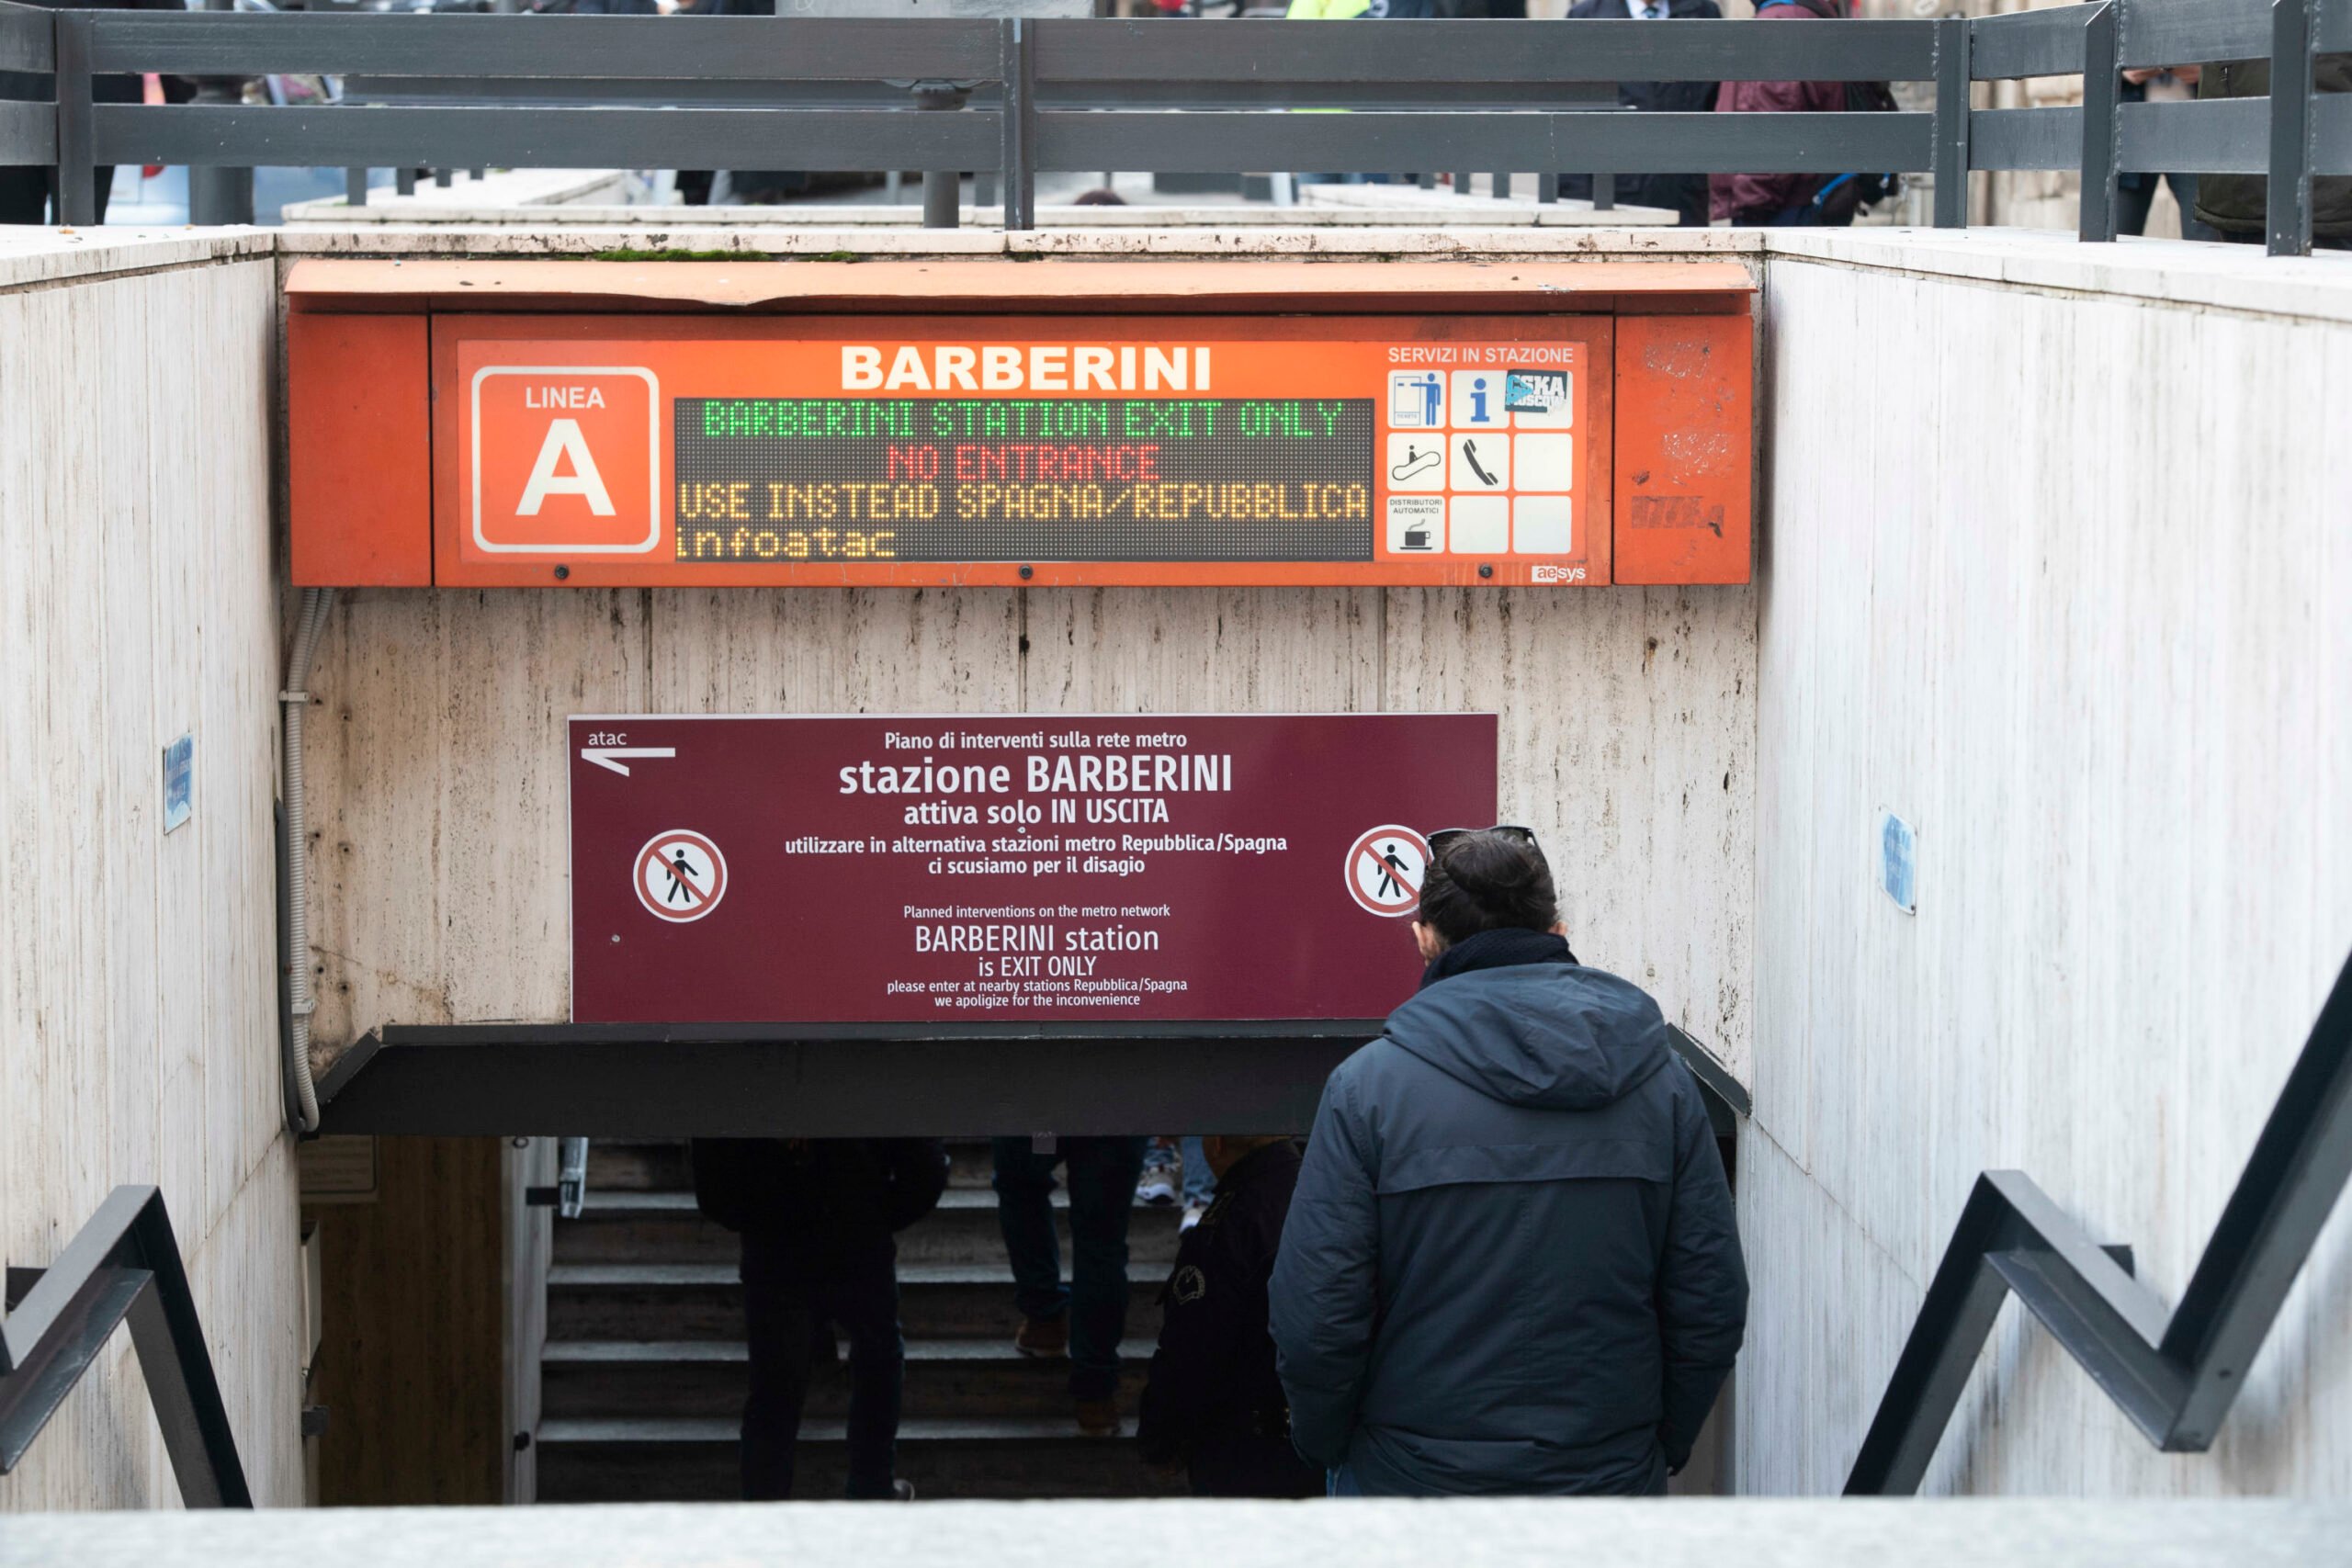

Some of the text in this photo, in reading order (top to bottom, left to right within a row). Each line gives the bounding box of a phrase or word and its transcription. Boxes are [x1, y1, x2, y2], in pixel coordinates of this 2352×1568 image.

[1388, 347, 1574, 364] SERVIZI IN STAZIONE
[842, 345, 1211, 391] BARBERINI
[526, 387, 605, 409] LINEA
[704, 400, 1343, 436] BARBERINI STATION EXIT ONLY
[515, 419, 616, 516] A
[888, 446, 1161, 479] NO ENTRANCE
[680, 483, 1367, 519] USE INSTEAD SPAGNA/REPUBBLICA
[676, 526, 896, 558] infoatac
[1537, 566, 1587, 584] aesys
[588, 731, 627, 746] atac
[885, 731, 1188, 750] Piano di interventi sulla rete metro
[839, 754, 1231, 795] stazione BARBERINI
[904, 797, 1170, 825] attiva solo IN USCITA
[785, 832, 1288, 855] utilizzare in alternativa stazioni metro Repubblica/Spagna
[928, 855, 1146, 877] ci scusiamo per il disagio
[903, 903, 1170, 919] Planned interventions on the metro network
[915, 924, 1159, 953] BARBERINI station
[978, 955, 1097, 977] is EXIT ONLY
[887, 976, 1188, 995] please enter at nearby stations Repubblica/Spagna
[934, 992, 1141, 1010] we apoligize for the inconvenience
